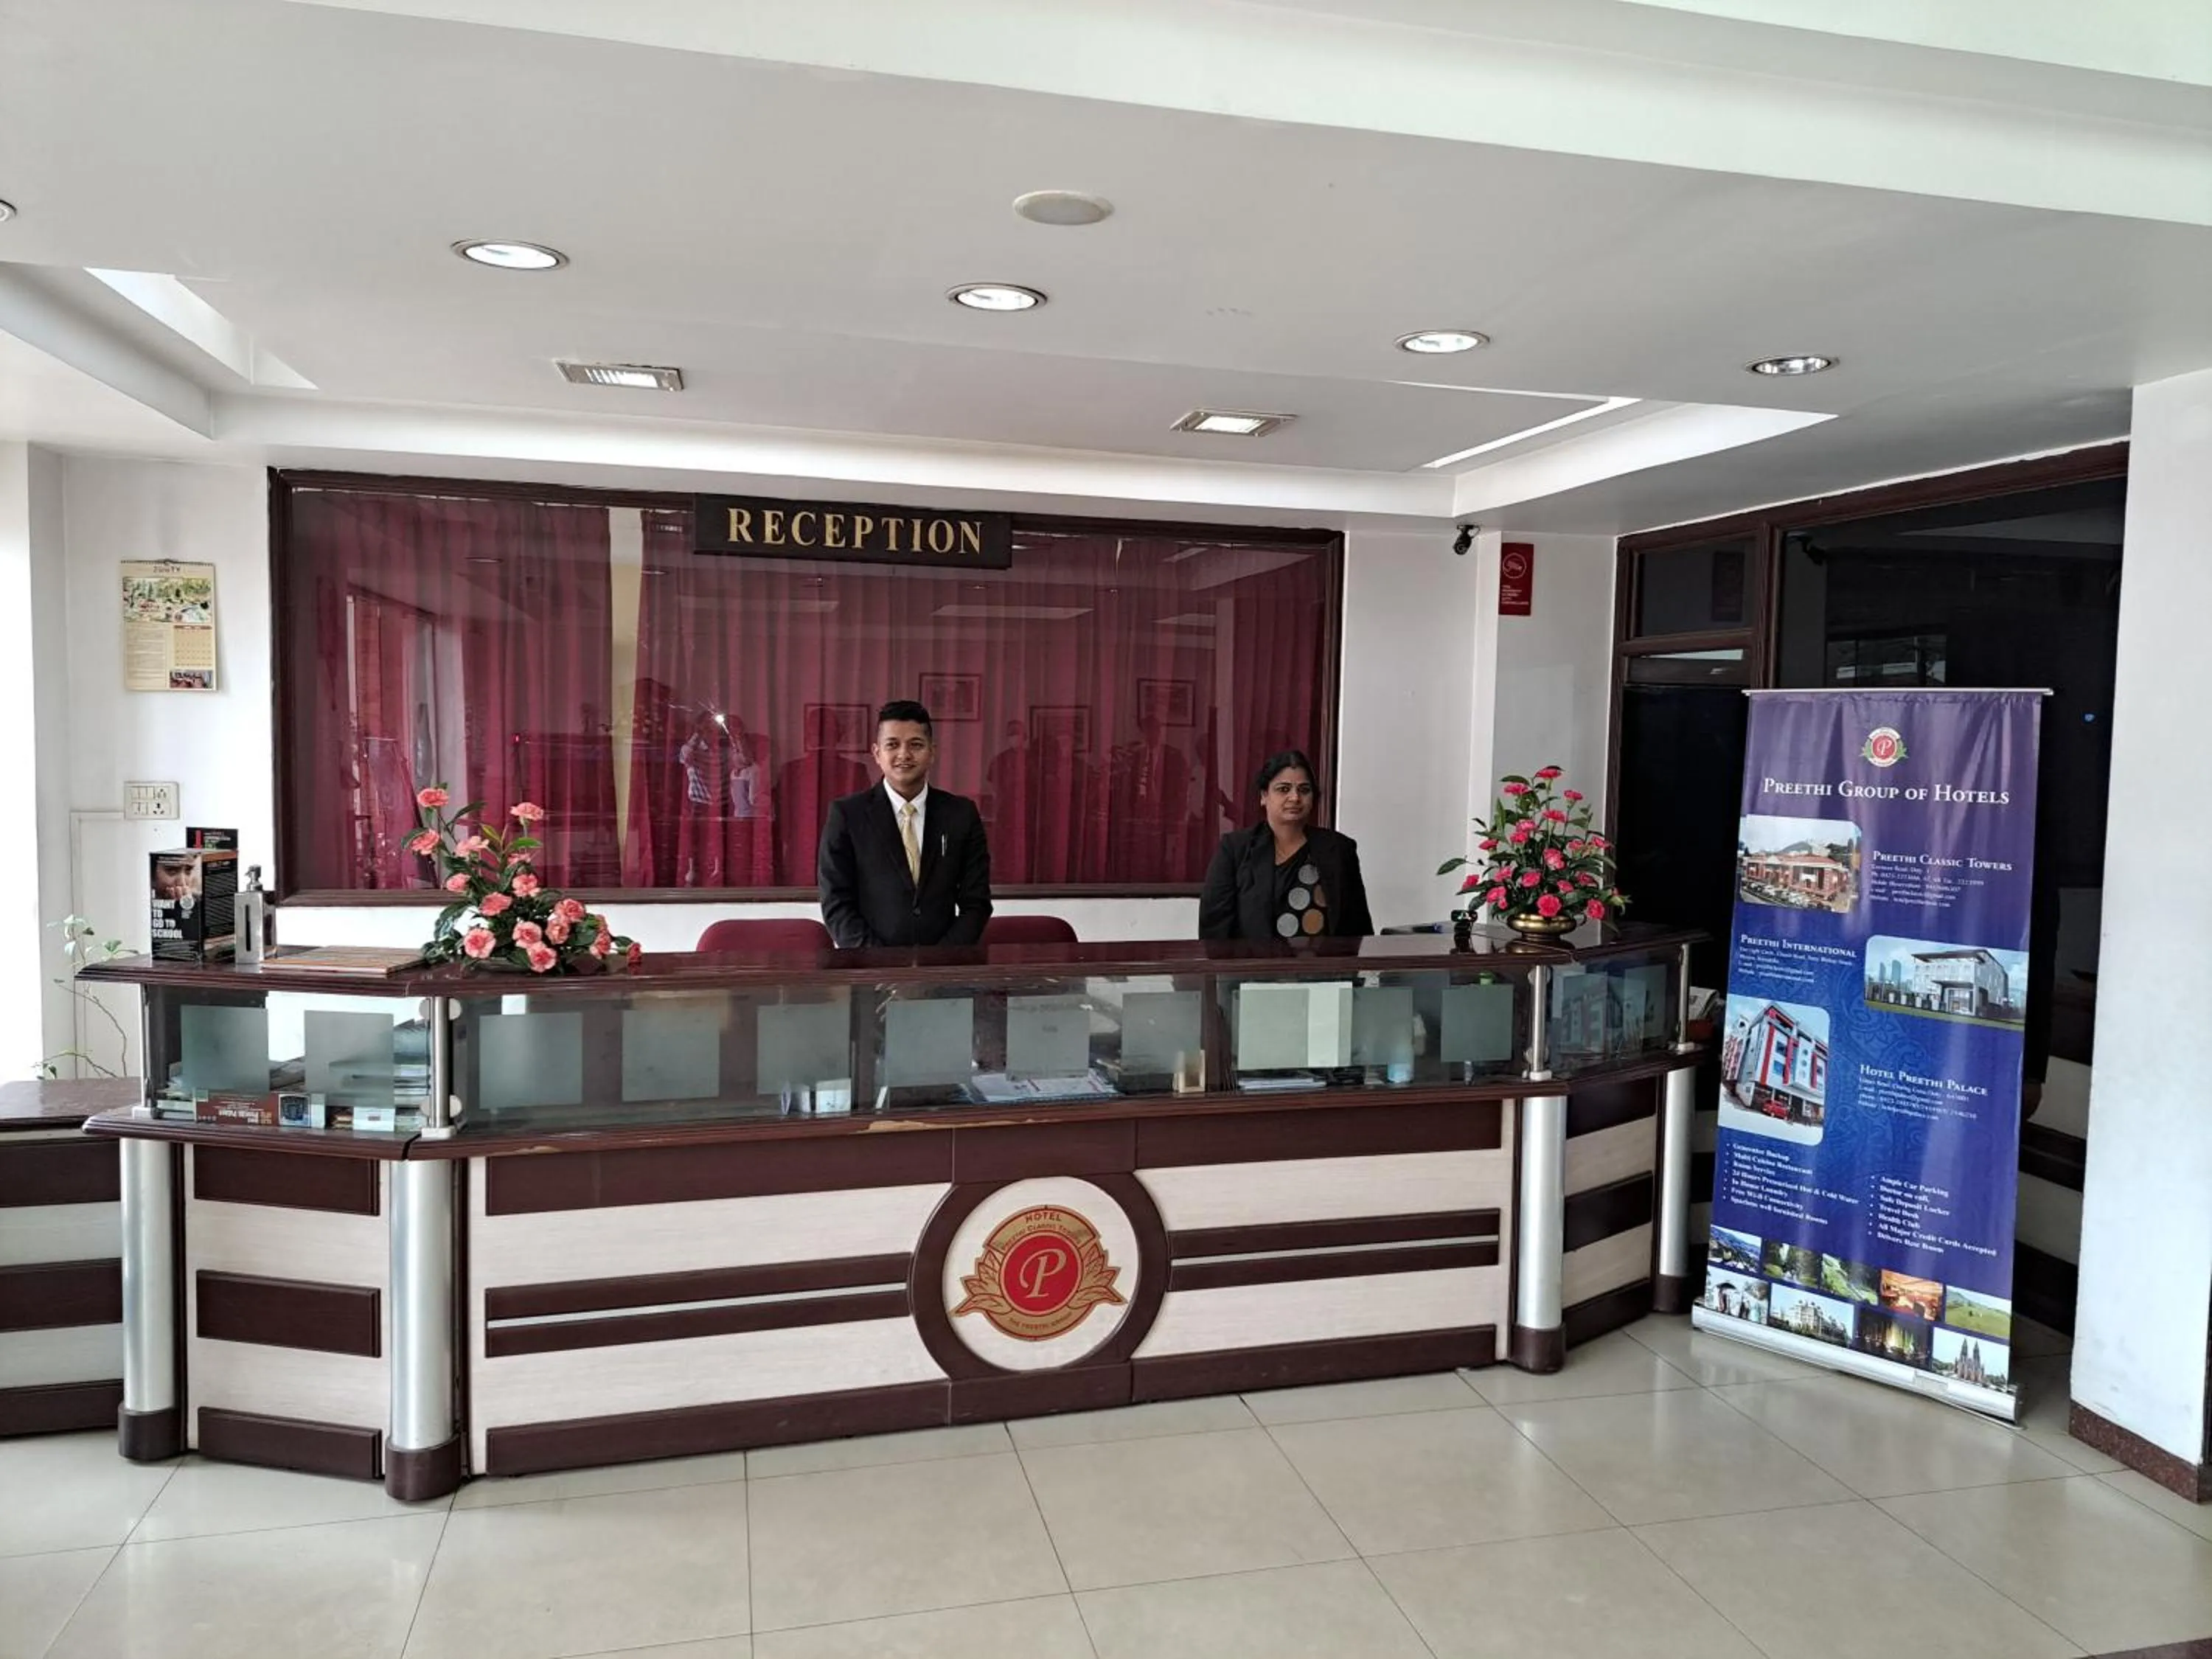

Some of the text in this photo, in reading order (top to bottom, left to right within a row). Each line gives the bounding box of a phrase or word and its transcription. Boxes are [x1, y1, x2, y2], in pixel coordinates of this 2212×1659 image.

[727, 507, 984, 554] RECEPTION
[1763, 777, 2010, 805] PREETHI GROUP OF HOTELS
[1873, 850, 2013, 872] PREETHI CLASSIC TOWERS
[152, 900, 175, 909] WANT
[153, 909, 163, 918] TO
[153, 918, 176, 928] GO TO
[153, 928, 183, 938] SCHOOL
[1741, 934, 1779, 947] PREETHI
[1782, 939, 1857, 958] INTERNATIONAL
[1860, 1064, 1894, 1079] HOTEL
[1899, 1071, 1943, 1088] PREETHI
[1947, 1079, 1989, 1096] PALACE
[1903, 1180, 1917, 1190] Car
[1919, 1185, 1950, 1199] Parking
[1026, 1211, 1062, 1223] HOTEL
[1019, 1248, 1067, 1299] P
